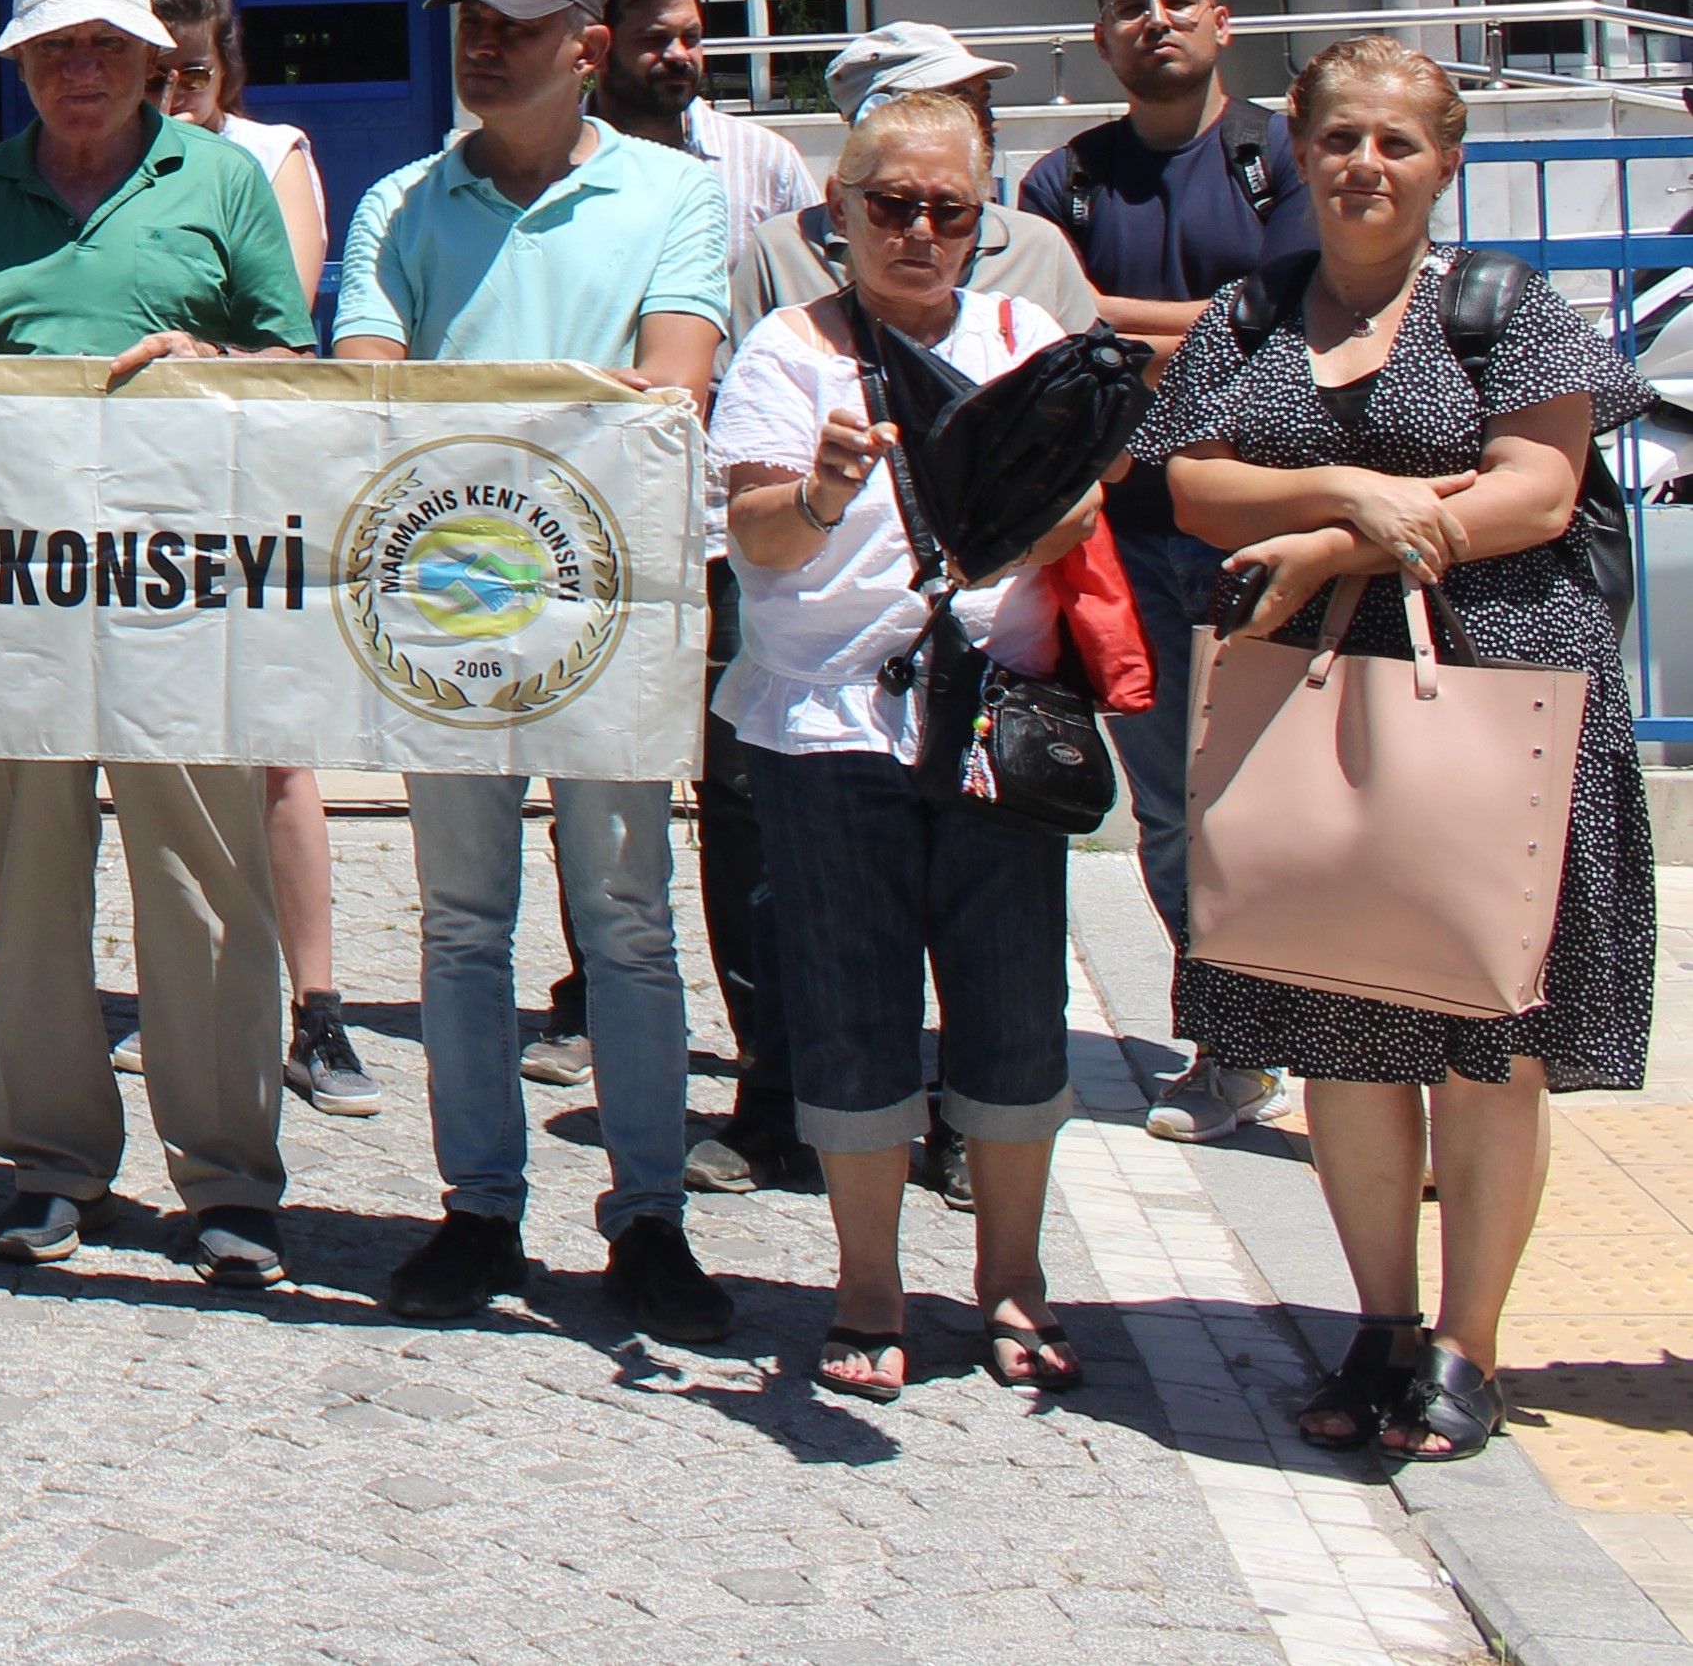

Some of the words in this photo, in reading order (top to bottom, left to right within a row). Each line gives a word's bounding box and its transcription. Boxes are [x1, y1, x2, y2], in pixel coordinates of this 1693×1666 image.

[380, 490, 458, 593] MARMARİS
[465, 485, 529, 514] KENT
[528, 506, 585, 604] KONSEYİ
[453, 660, 503, 679] 2006
